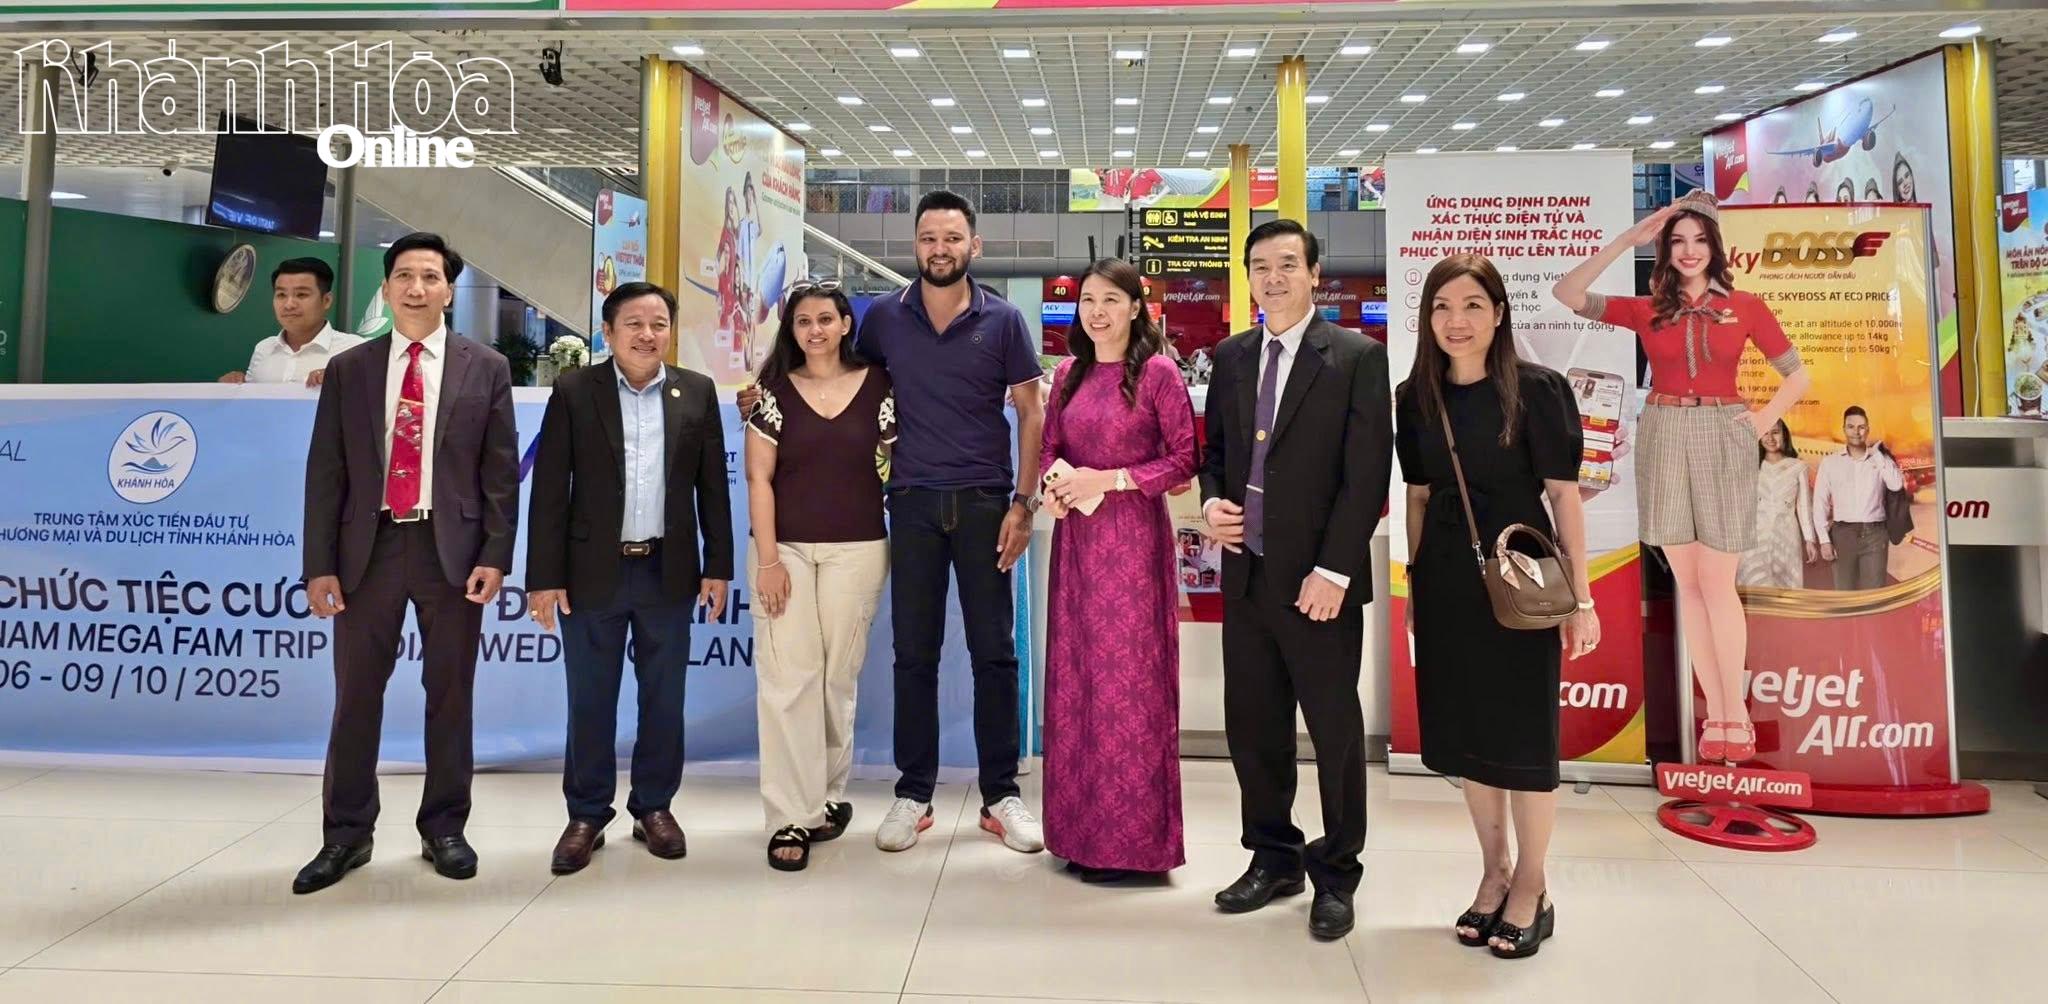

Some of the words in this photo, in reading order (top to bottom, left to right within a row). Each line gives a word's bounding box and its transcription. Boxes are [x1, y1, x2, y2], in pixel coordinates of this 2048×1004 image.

[1427, 194, 1457, 209] ỨNG
[1461, 197, 1503, 211] DỤNG
[1506, 196, 1544, 210] ĐỊNH
[1547, 196, 1590, 207] DANH
[1431, 211, 1460, 224] XÁC
[1464, 212, 1502, 227] THỰC
[1506, 210, 1540, 227] ĐIỆN
[1566, 210, 1585, 224] VÀ
[1412, 228, 1454, 244] NHẬN
[1457, 227, 1492, 243] DIỆN
[1495, 230, 1527, 240] SINH
[1531, 225, 1568, 240] TRẮC
[1572, 230, 1603, 243] HỌC
[1400, 247, 1438, 260] PHỤC
[1497, 246, 1524, 260] TỤC
[1528, 243, 1555, 256] LÊN
[1559, 243, 1587, 256] TÀU
[1512, 272, 1540, 282] dụng
[1054, 286, 1066, 295] 40
[1143, 287, 1150, 295] 9
[1531, 291, 1538, 299] &
[1777, 292, 1826, 301] SKYBOSS
[1829, 292, 1841, 301] AT
[1844, 292, 1863, 301] ECO
[1522, 303, 1541, 313] học
[1533, 322, 1546, 330] an
[1548, 321, 1571, 330] ninh
[1573, 321, 1584, 332] tự
[1587, 321, 1614, 332] động
[1795, 320, 1804, 328] at
[1807, 320, 1817, 328] an
[1820, 320, 1851, 328] altitude
[1854, 320, 1863, 328] of
[1868, 333, 1888, 342] 14kg
[1802, 345, 1843, 353] allowance
[1869, 345, 1889, 354] 50kg
[117, 477, 152, 488] KHÁNH
[154, 477, 175, 488] HÒA
[34, 512, 84, 526] TRUNG
[88, 510, 119, 526] TÂM
[122, 511, 154, 527] XÚC
[158, 510, 191, 527] TIẾN
[53, 529, 80, 546] MẠI
[84, 527, 103, 542] VÀ
[106, 530, 127, 543] DU
[130, 531, 164, 547] LỊCH
[168, 528, 203, 545] TỈNH
[205, 529, 260, 546] KHÁNH
[263, 530, 296, 546] HÒA
[117, 570, 211, 624] TIỆC
[68, 622, 163, 655] MEGA
[173, 626, 243, 658] FAM
[253, 629, 328, 659] TRIP
[61, 663, 104, 692] 09
[132, 666, 167, 695] 10
[195, 668, 280, 698] 2025
